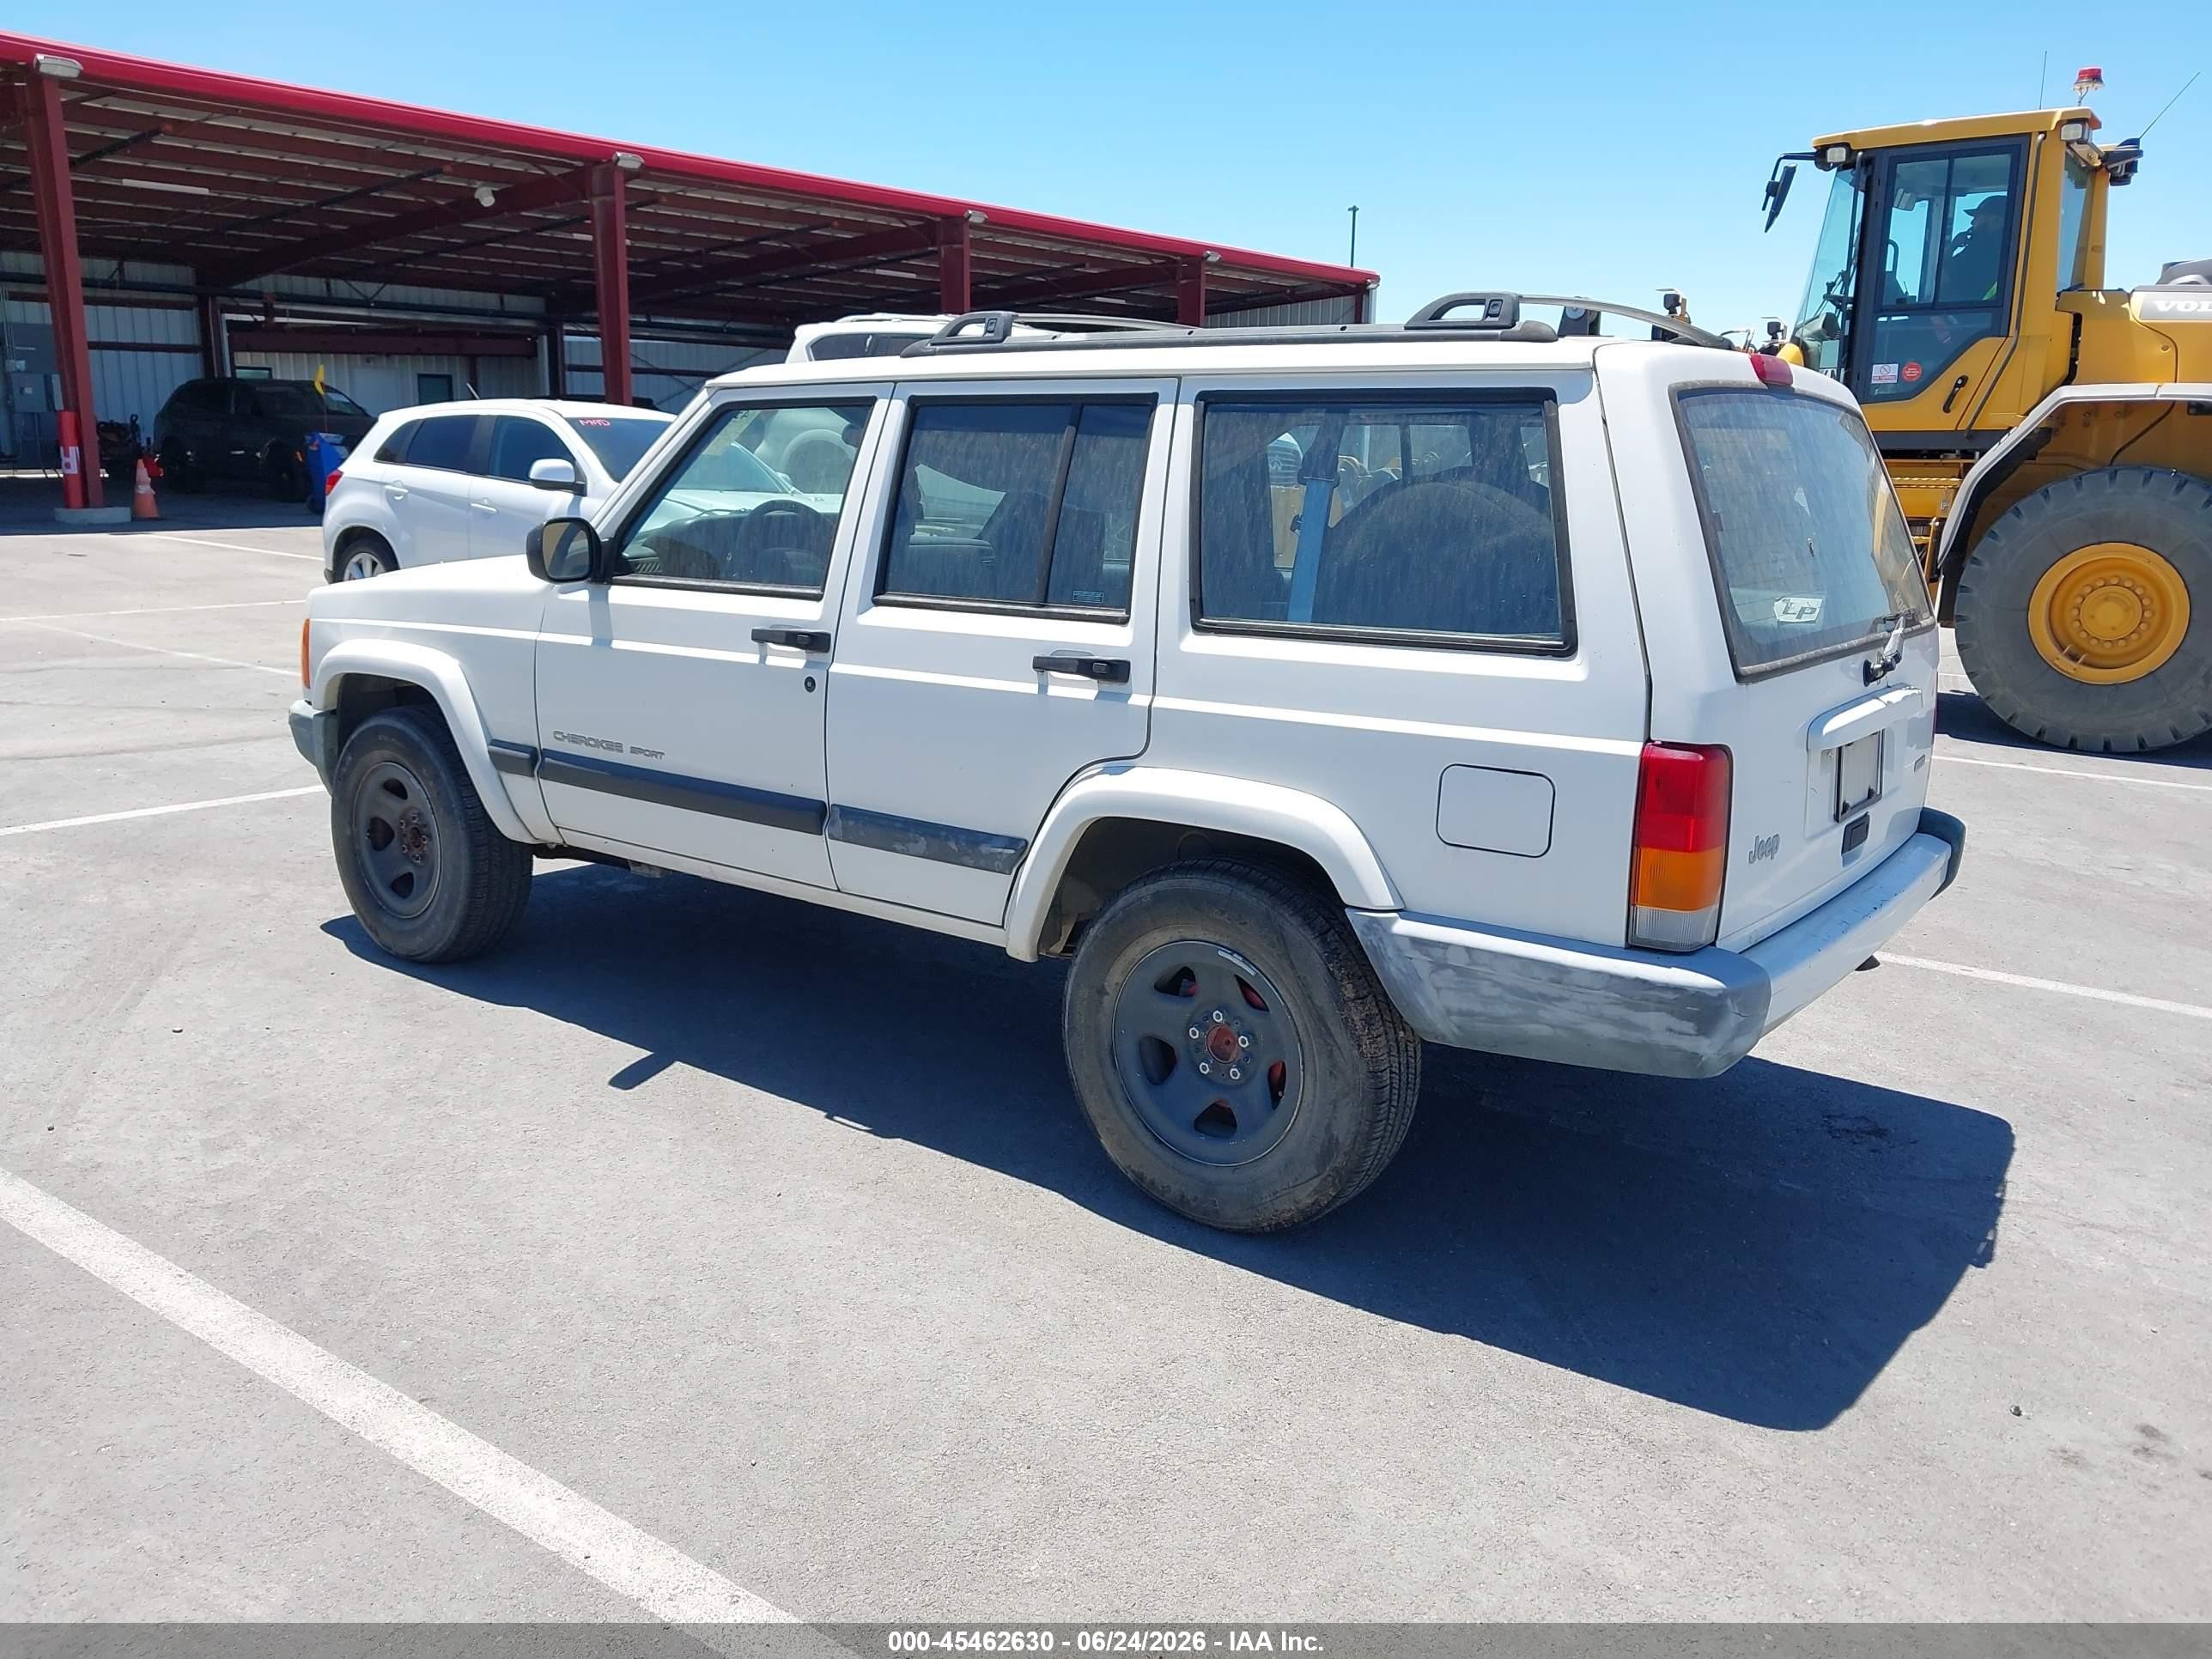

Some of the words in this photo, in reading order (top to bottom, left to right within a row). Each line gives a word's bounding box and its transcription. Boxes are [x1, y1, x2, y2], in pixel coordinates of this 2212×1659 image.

[552, 730, 624, 754] CHEROKEE
[629, 745, 665, 760] SPORT
[1747, 833, 1780, 864] Jeep
